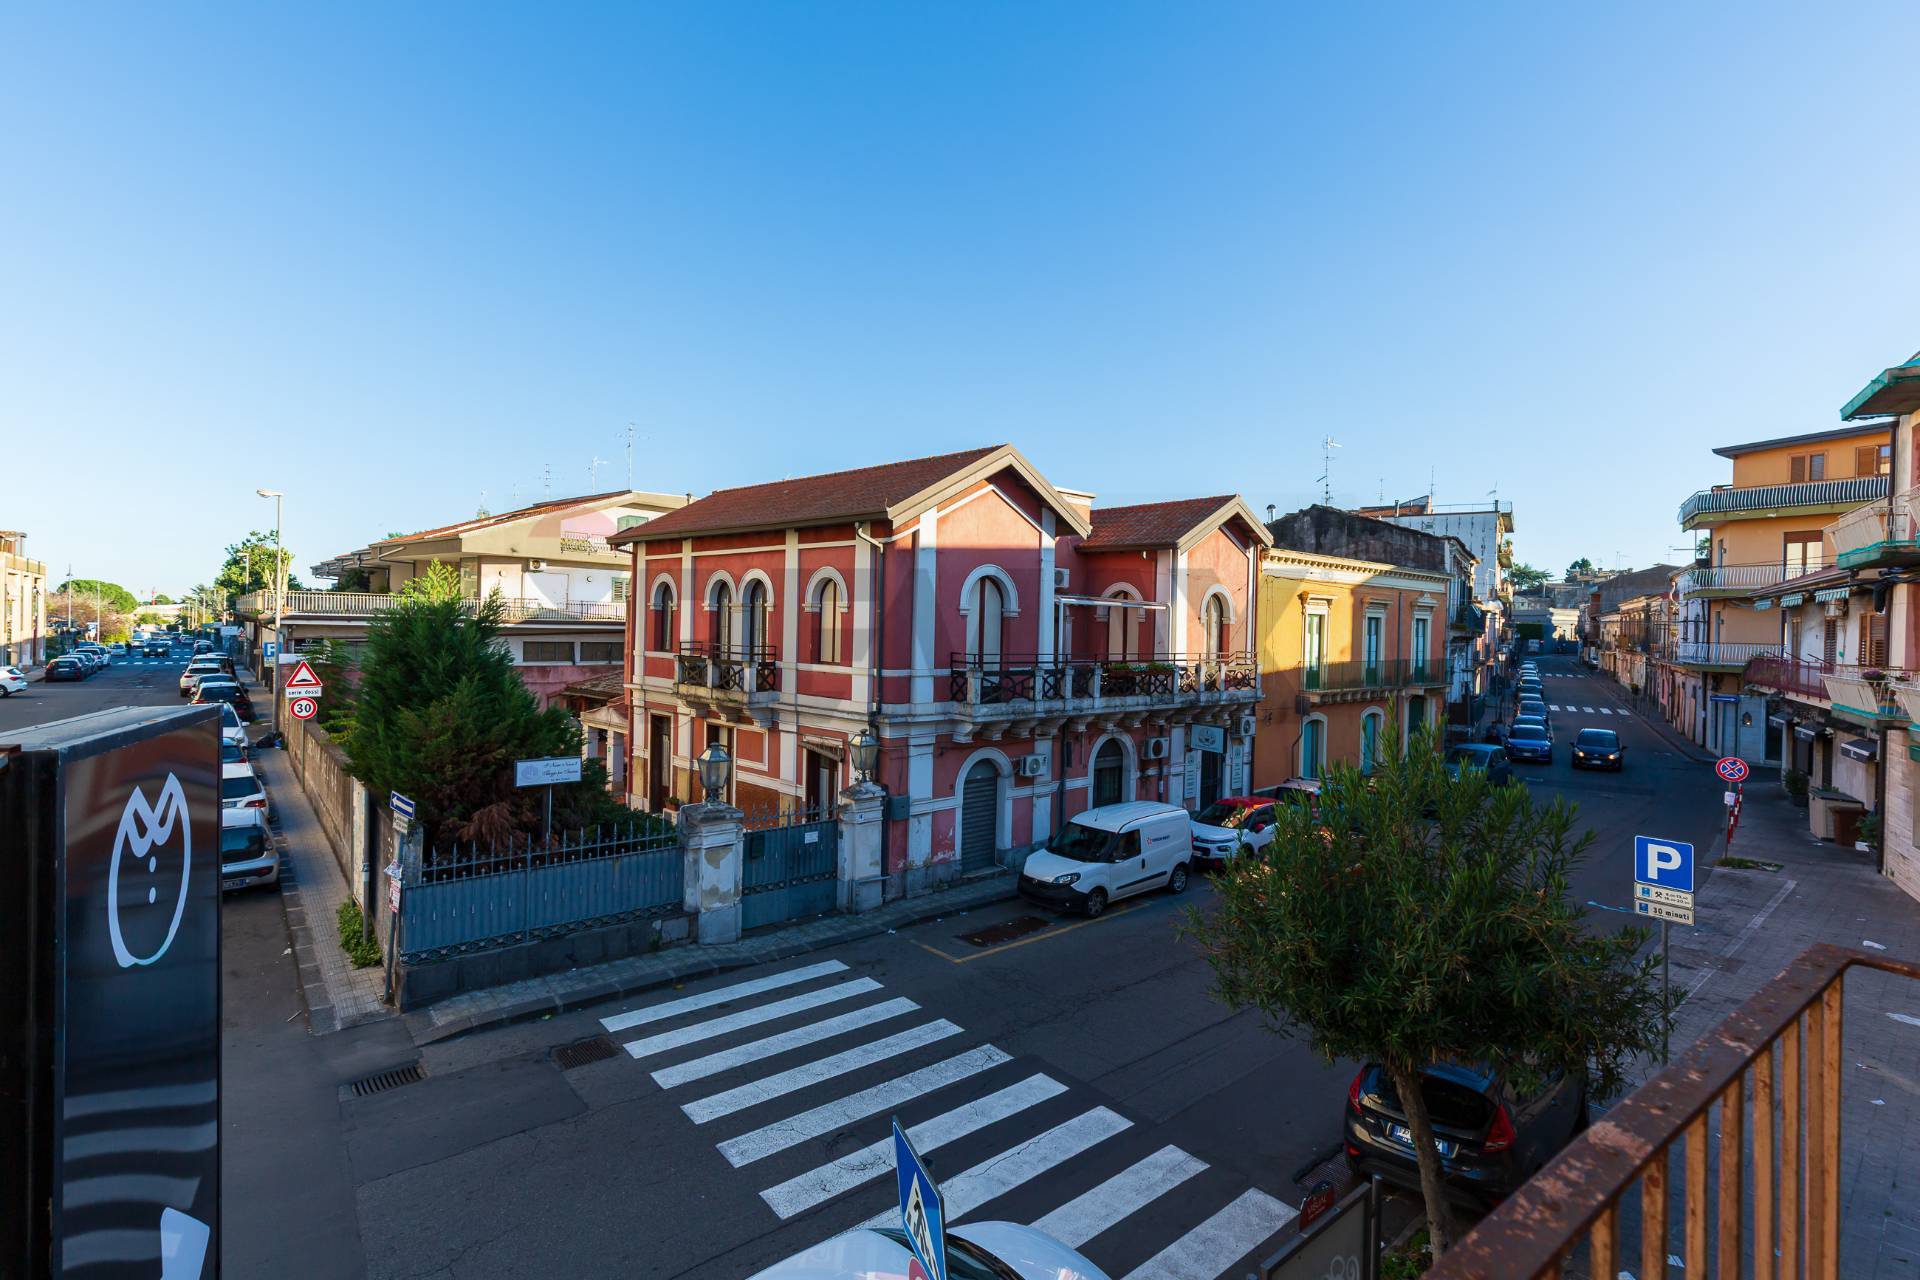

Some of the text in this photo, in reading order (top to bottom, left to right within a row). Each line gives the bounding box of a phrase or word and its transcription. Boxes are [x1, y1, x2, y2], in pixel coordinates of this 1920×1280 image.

[296, 703, 312, 713] 30
[1647, 843, 1682, 880] P
[1653, 906, 1690, 921] 30 minuti
